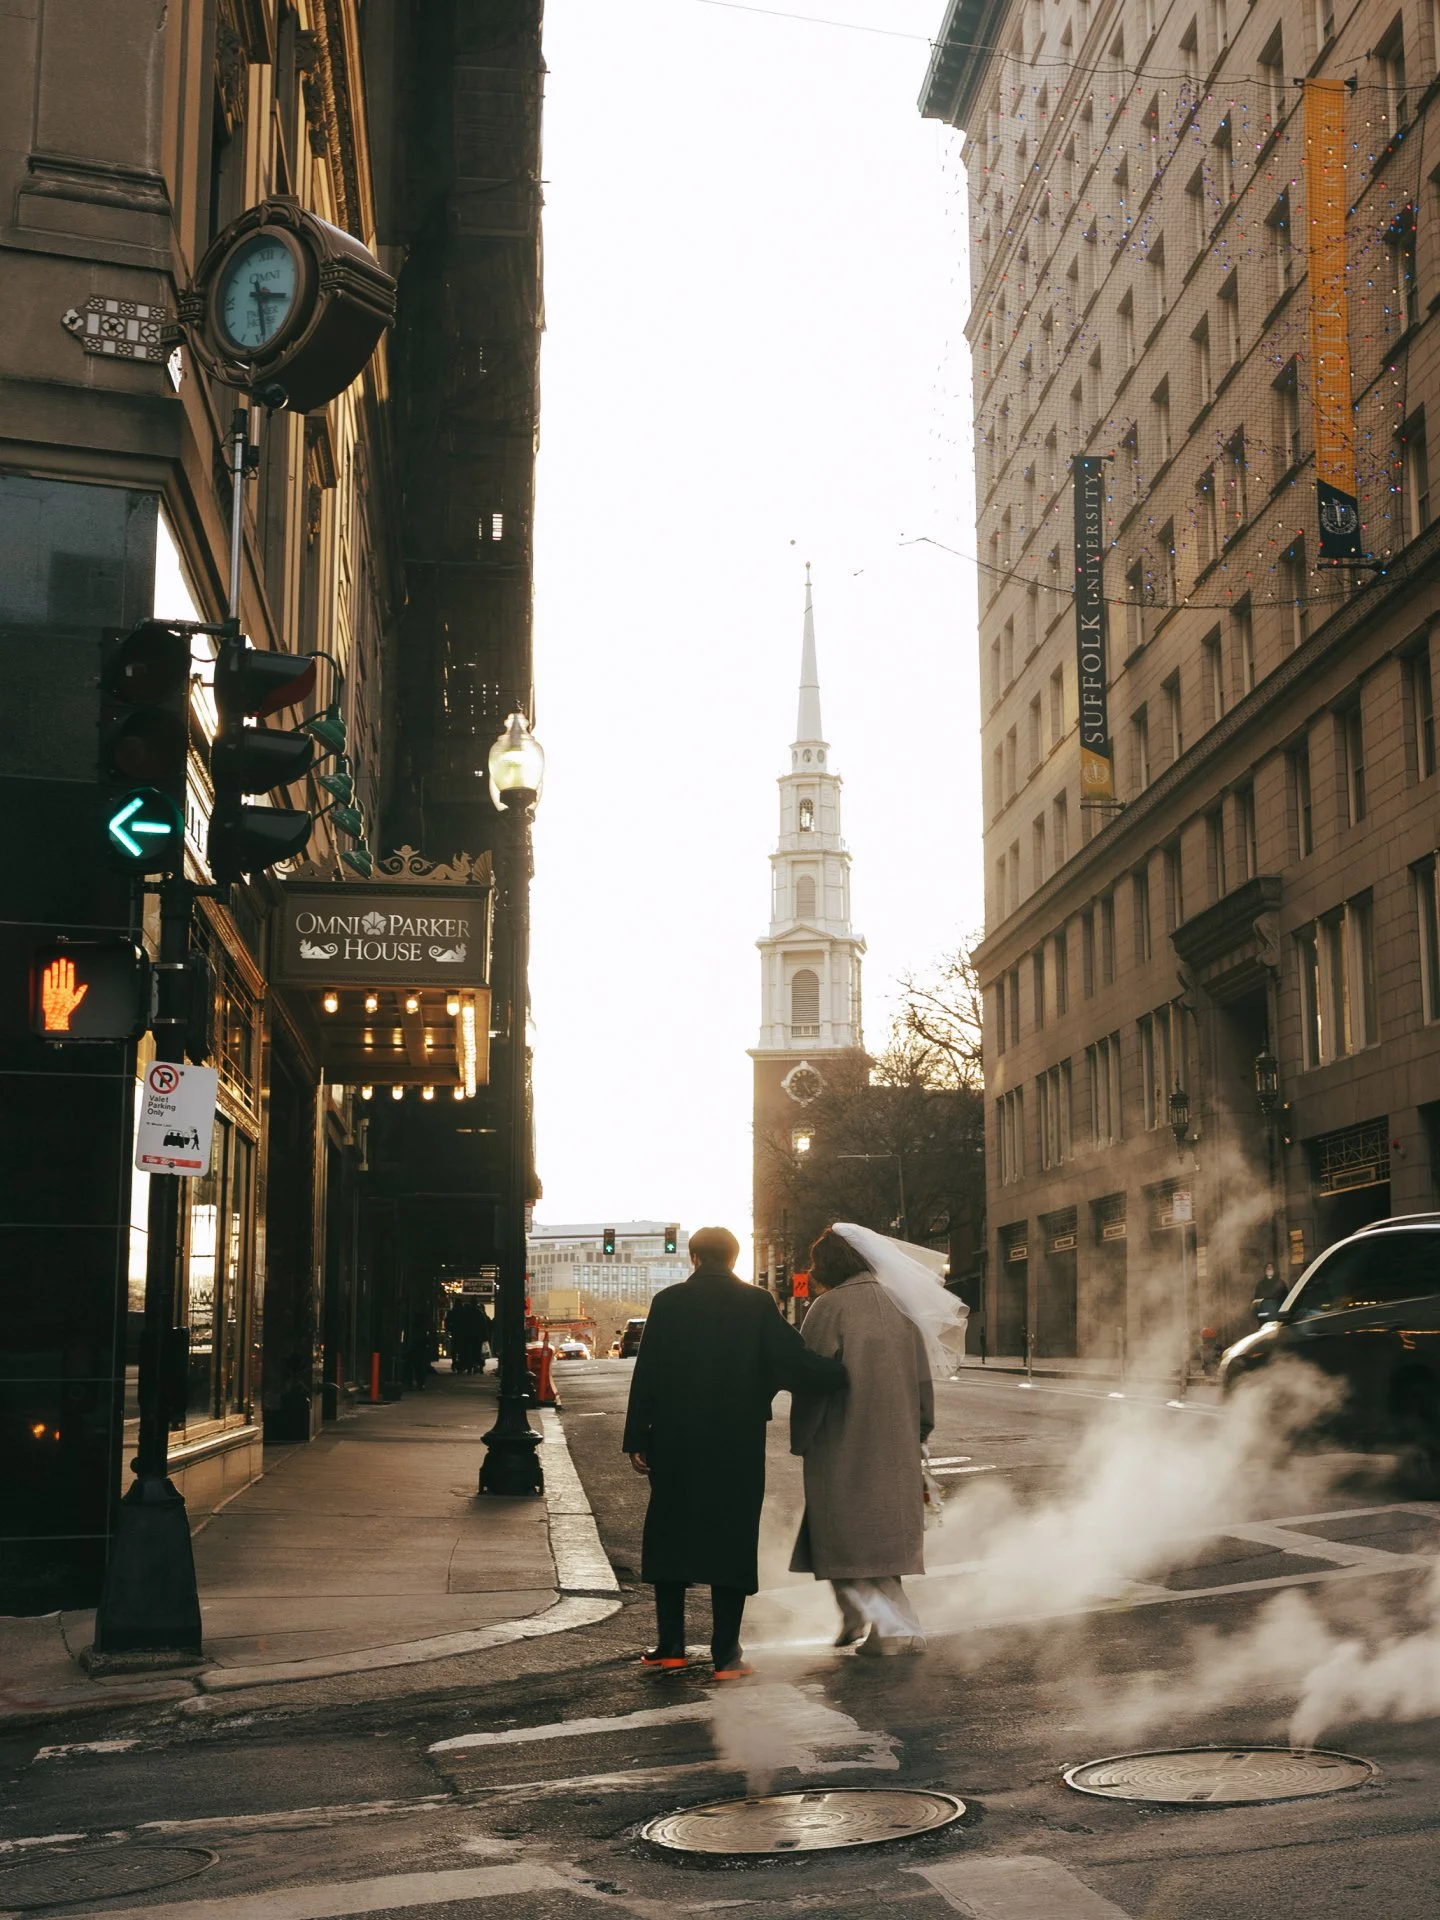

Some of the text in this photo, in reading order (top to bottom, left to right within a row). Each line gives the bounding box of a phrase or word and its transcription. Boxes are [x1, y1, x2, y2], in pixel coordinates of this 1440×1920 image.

[248, 270, 280, 285] OMNI
[246, 305, 279, 320] PAKER
[246, 315, 277, 329] HOSE
[1081, 474, 1104, 744] SUFFOLK UNIVERSITY
[295, 911, 471, 938] OMNI PARKER
[343, 938, 423, 961] HOUSE
[149, 1094, 169, 1103] Valet
[147, 1101, 176, 1112] Parking
[147, 1108, 165, 1117] Only
